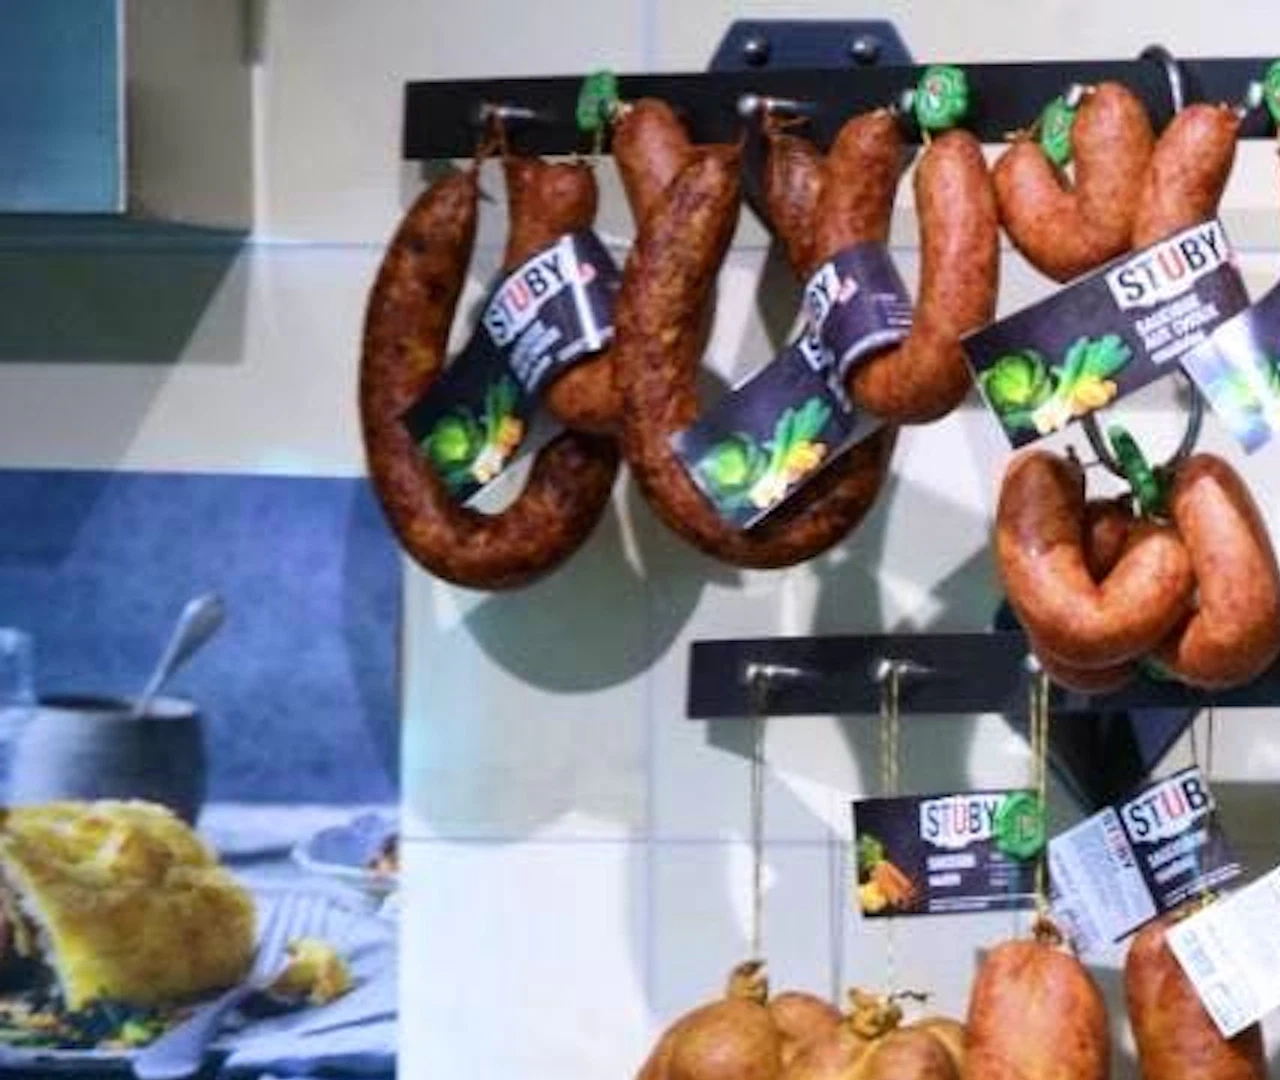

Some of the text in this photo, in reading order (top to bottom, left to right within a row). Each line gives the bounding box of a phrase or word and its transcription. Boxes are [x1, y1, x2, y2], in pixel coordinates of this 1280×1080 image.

[487, 253, 565, 340] STUBY
[1118, 228, 1220, 301] STUBY
[926, 801, 999, 838] STUBY
[1128, 777, 1208, 837] STUB
